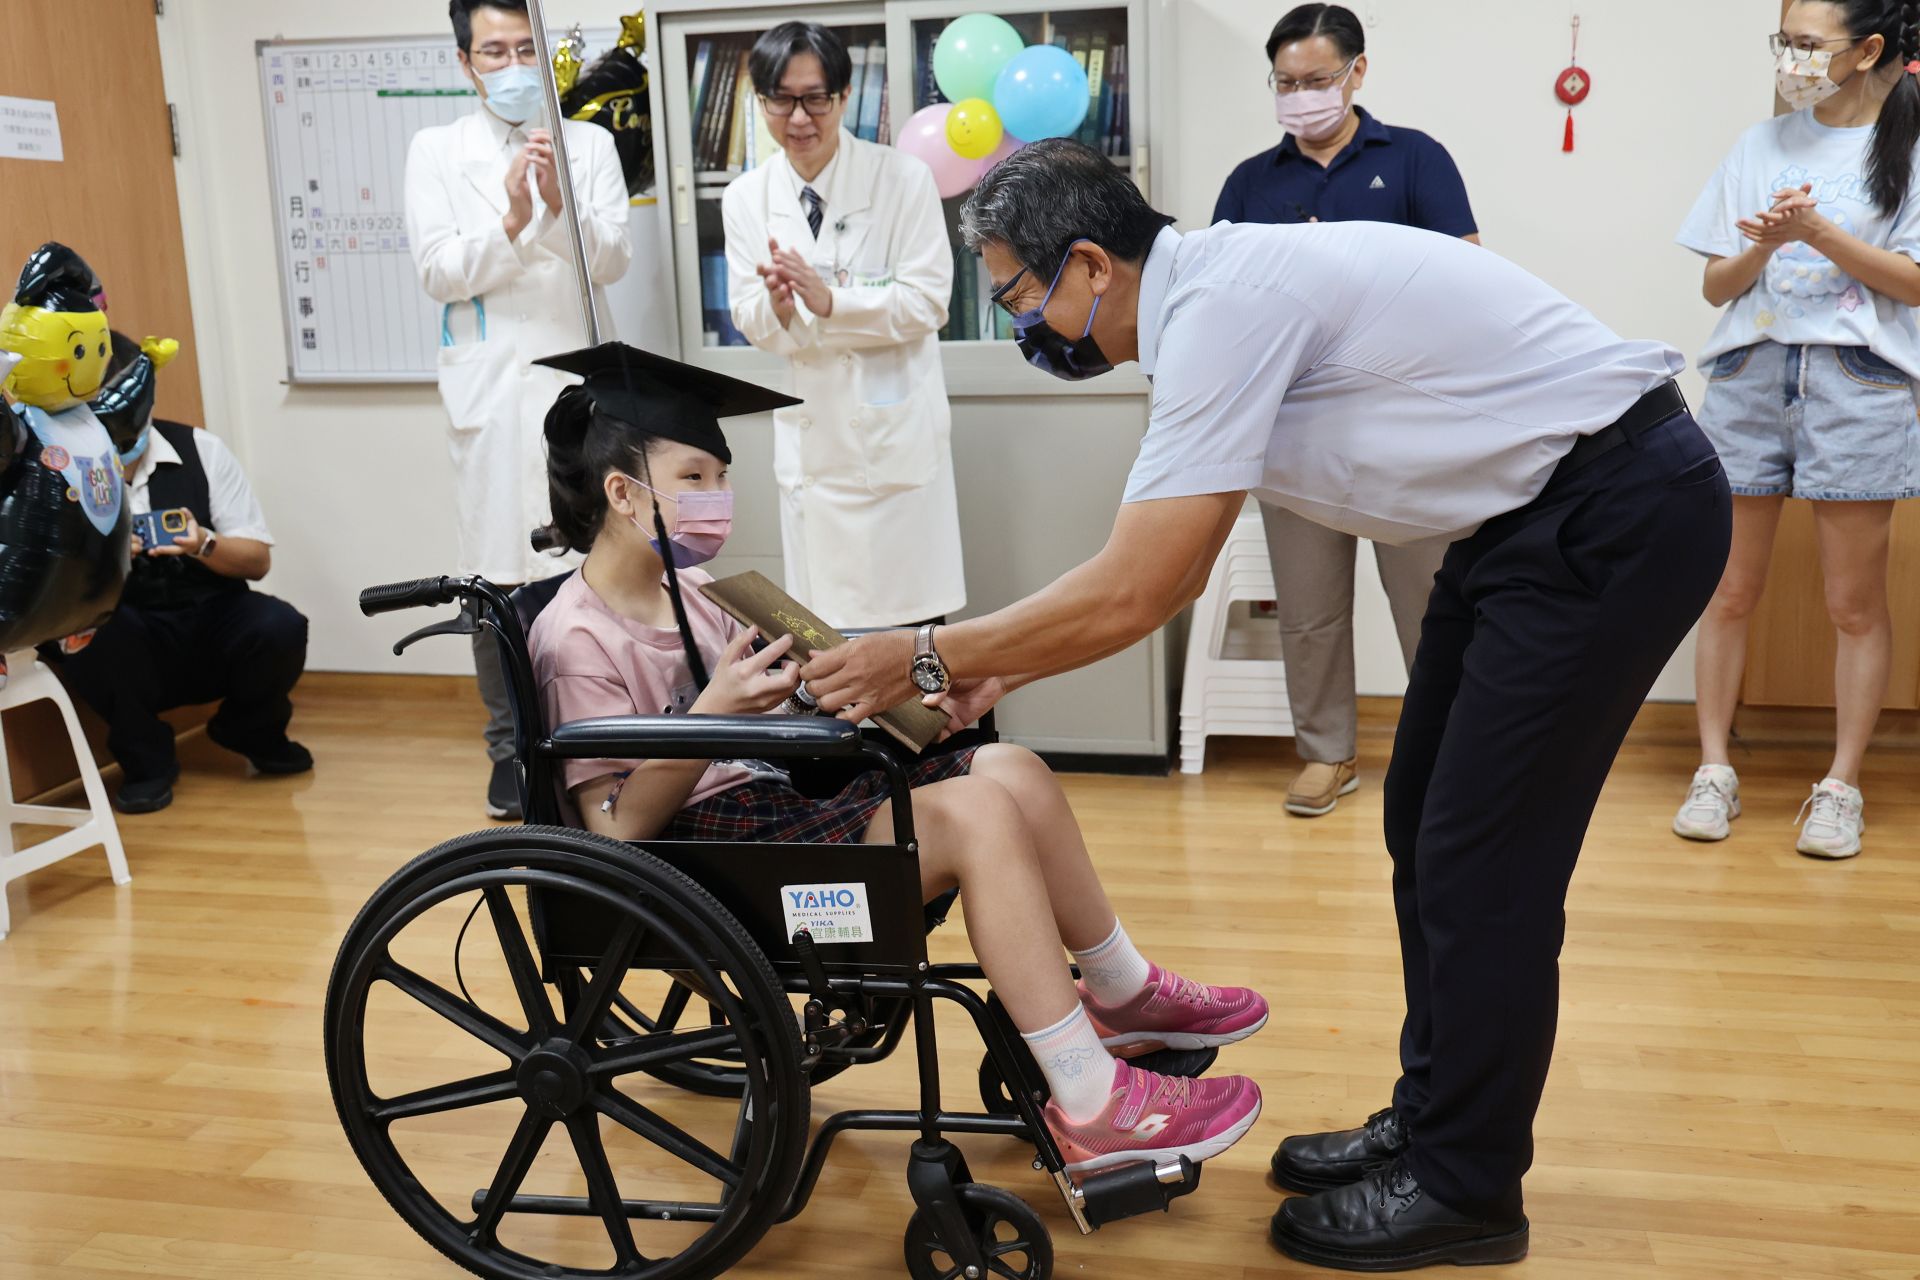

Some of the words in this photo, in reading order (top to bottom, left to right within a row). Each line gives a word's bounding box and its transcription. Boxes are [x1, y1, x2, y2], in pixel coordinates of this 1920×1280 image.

[332, 54, 341, 67] 2
[350, 54, 358, 66] 3
[367, 53, 376, 66] 4
[384, 52, 393, 65] 5
[402, 52, 411, 65] 6
[421, 51, 429, 64] 7
[437, 51, 446, 64] 8
[309, 220, 324, 232] 16
[327, 217, 340, 231] 17
[344, 217, 357, 231] 18
[361, 216, 375, 230] 19
[378, 216, 393, 230] 20
[788, 889, 855, 909] YAHO
